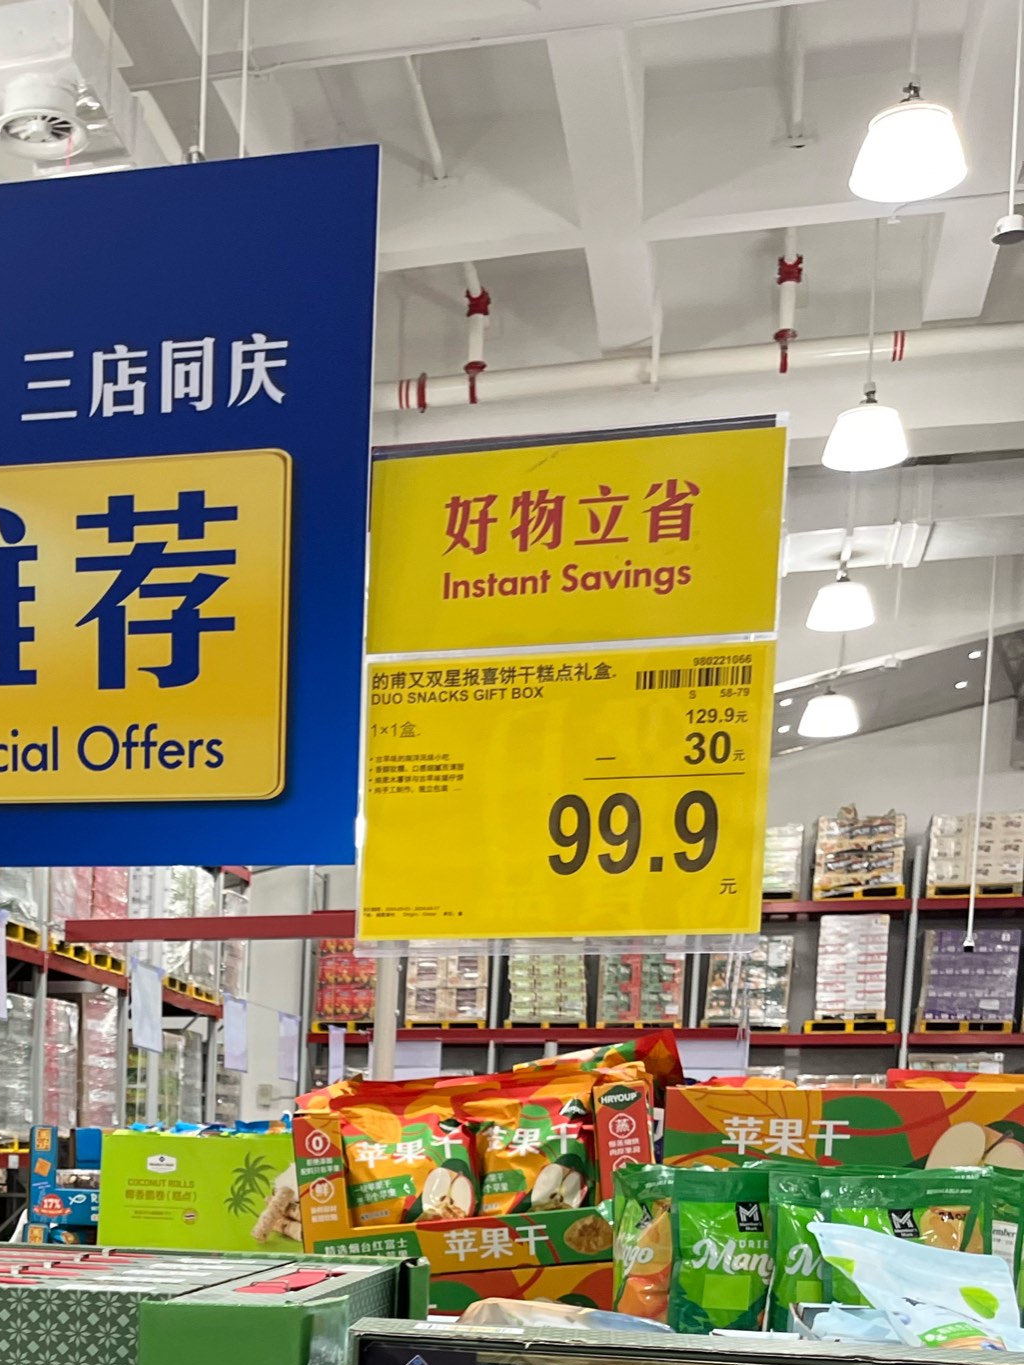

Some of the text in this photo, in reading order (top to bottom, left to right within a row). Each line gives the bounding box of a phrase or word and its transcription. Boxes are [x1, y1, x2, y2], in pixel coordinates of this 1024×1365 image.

[21, 333, 289, 423] 三店同庆
[442, 478, 701, 556] 好物立省
[442, 560, 692, 600] Instant Savings
[371, 686, 544, 706] DUO SNACKS GIFT BOX
[686, 707, 748, 724] 129.9元
[77, 724, 225, 773] Offers
[548, 790, 719, 876] 99.9
[720, 878, 737, 895] 元
[722, 1115, 851, 1157] 苹果干
[444, 1224, 549, 1262] 苹果干
